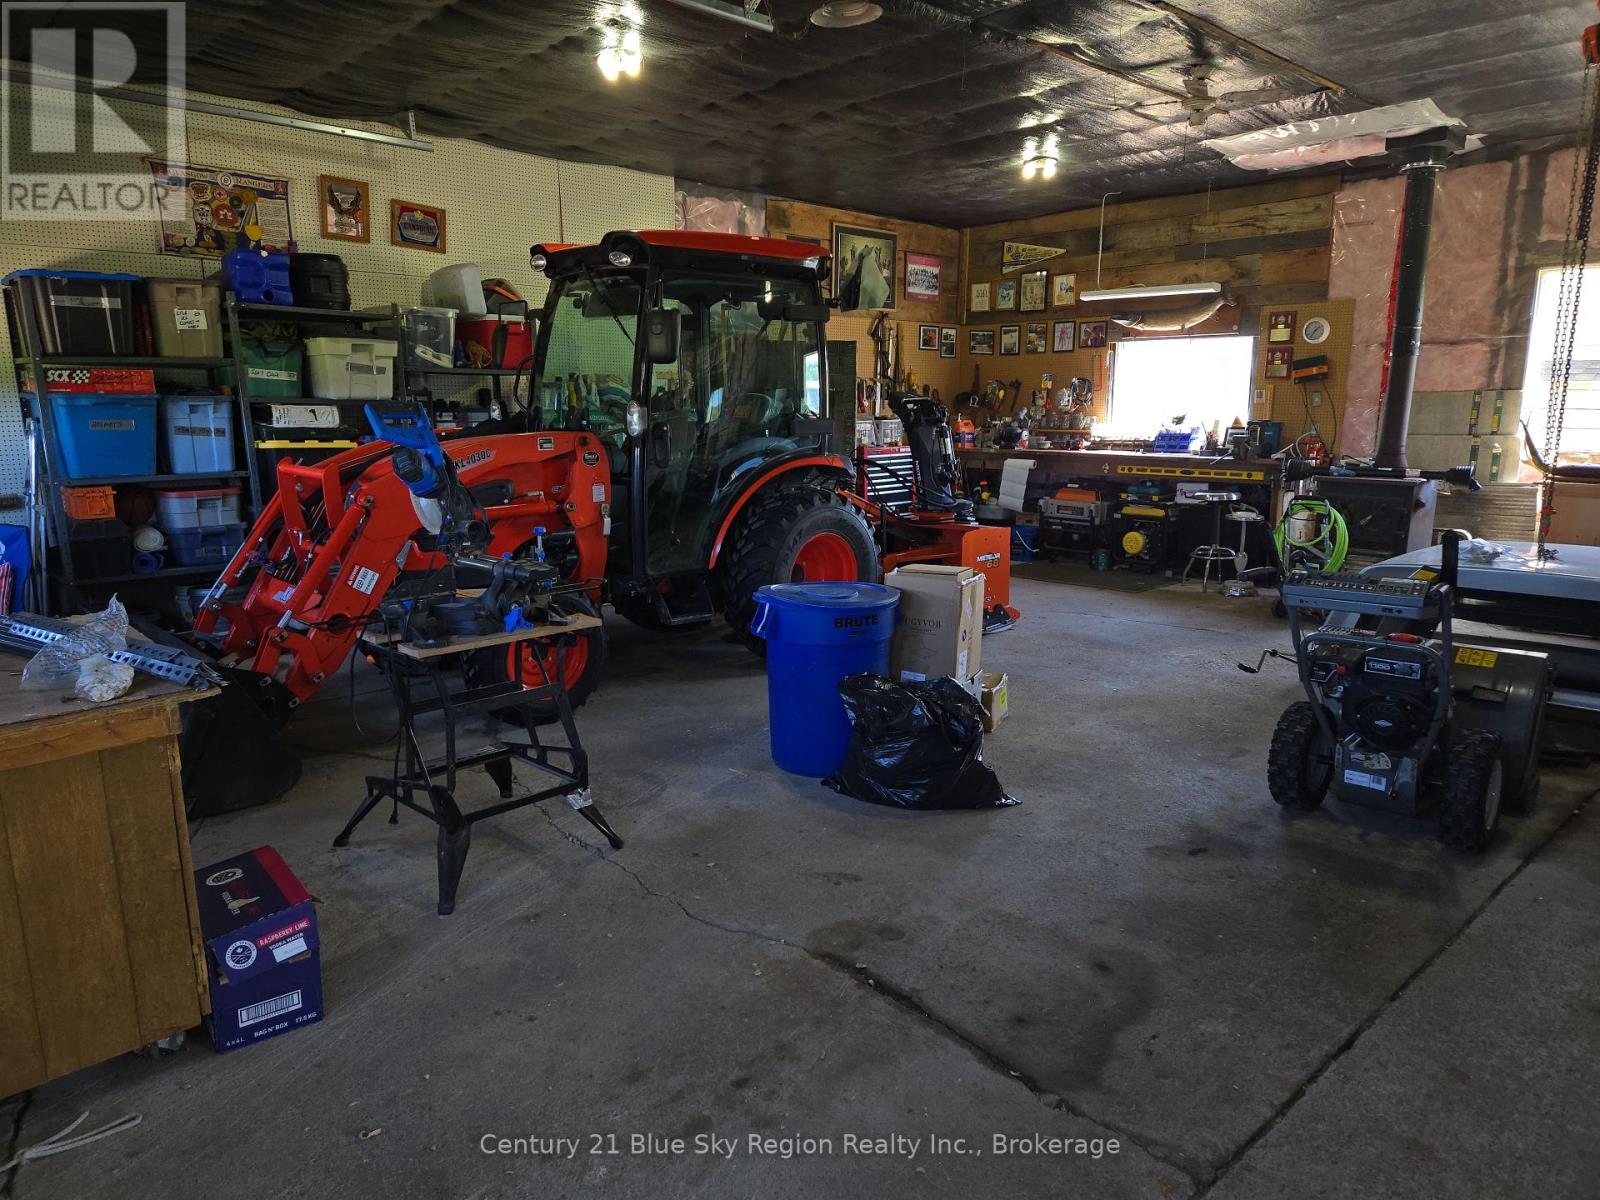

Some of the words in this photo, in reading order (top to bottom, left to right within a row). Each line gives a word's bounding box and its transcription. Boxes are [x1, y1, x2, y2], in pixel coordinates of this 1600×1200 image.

[46, 370, 71, 382] SCX
[834, 614, 879, 629] BRUTE
[259, 927, 294, 946] RASPBERRY
